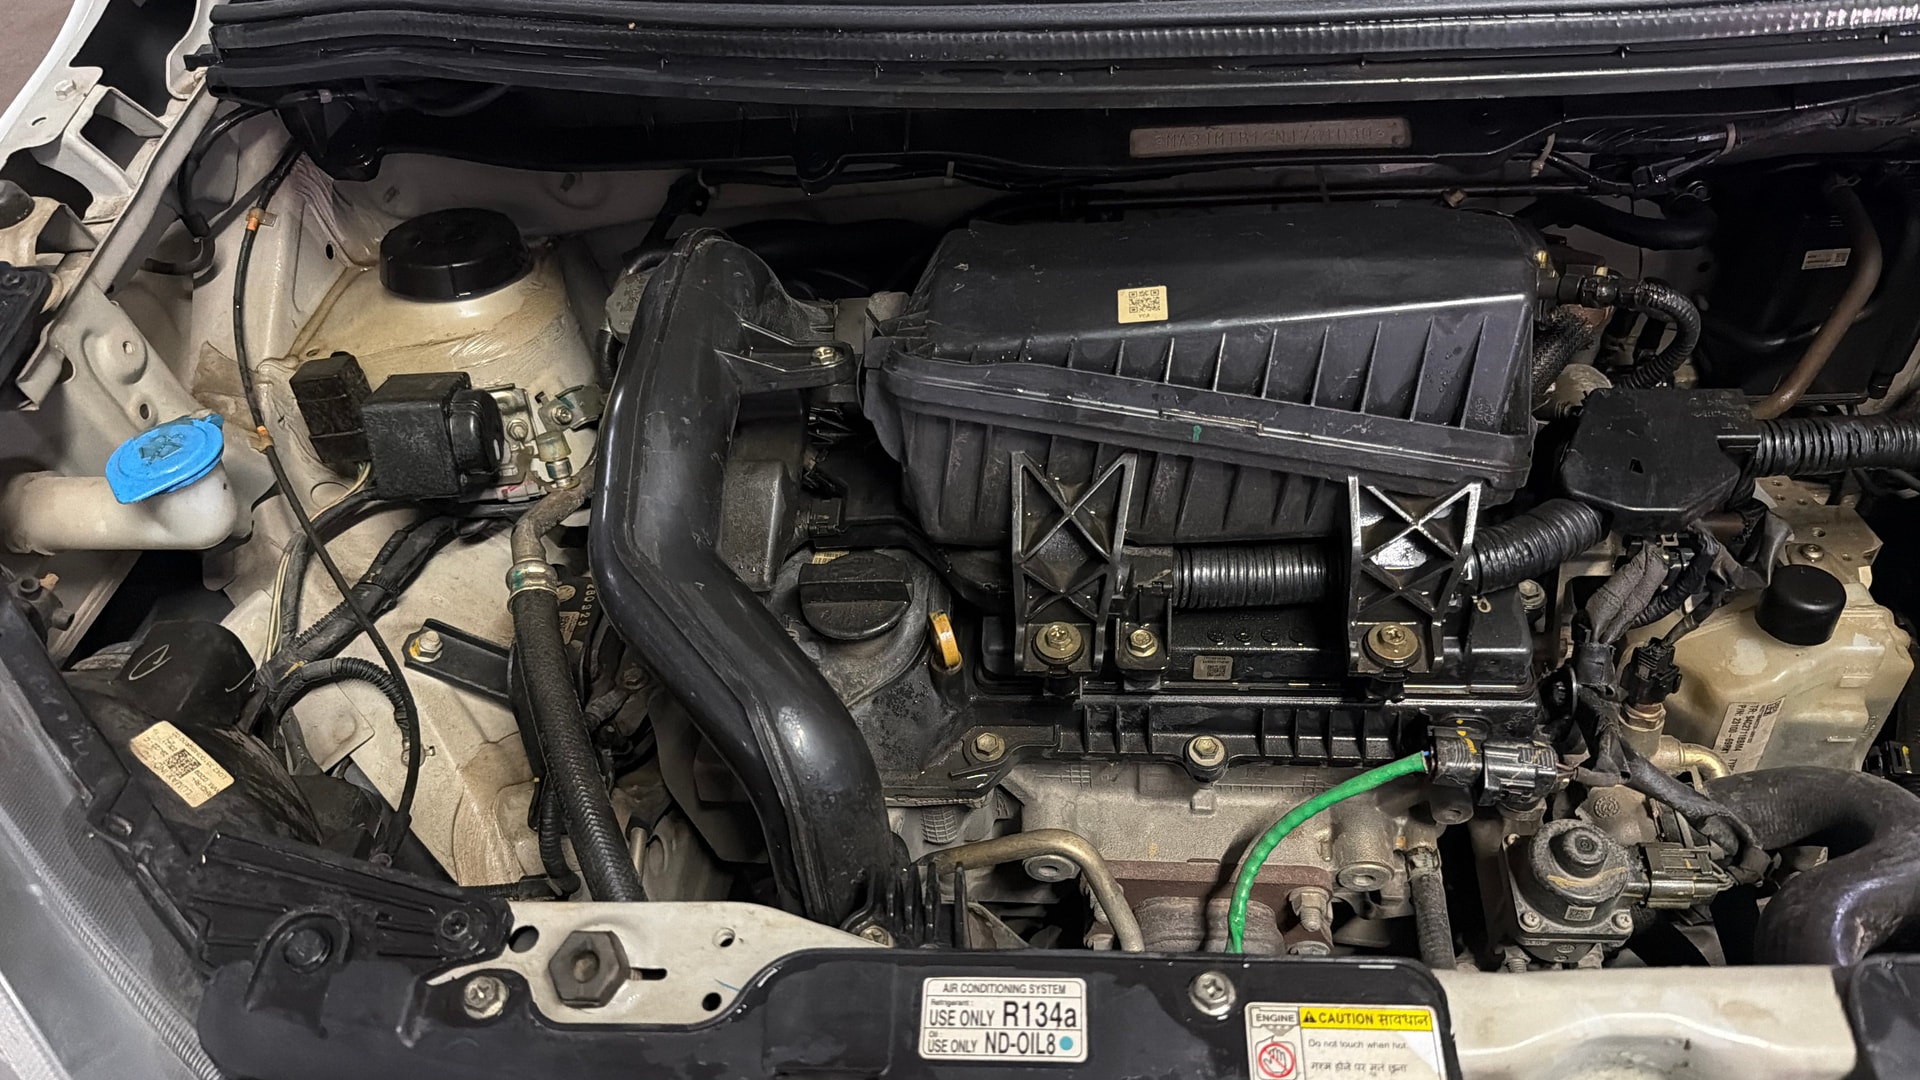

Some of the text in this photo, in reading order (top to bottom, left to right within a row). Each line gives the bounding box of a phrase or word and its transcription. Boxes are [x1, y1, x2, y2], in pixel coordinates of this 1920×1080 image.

[943, 983, 1066, 994] AIR CONDITIONING SYSTEM
[929, 1000, 1077, 1027] USE ONLY R134a
[1256, 1013, 1295, 1022] ENGINE
[1318, 1012, 1374, 1025] CAUTION
[928, 1031, 1056, 1054] USE ONLY ND-OIL8
[1308, 1039, 1321, 1048] Do
[1324, 1040, 1338, 1048] not
[1367, 1040, 1390, 1049] when
